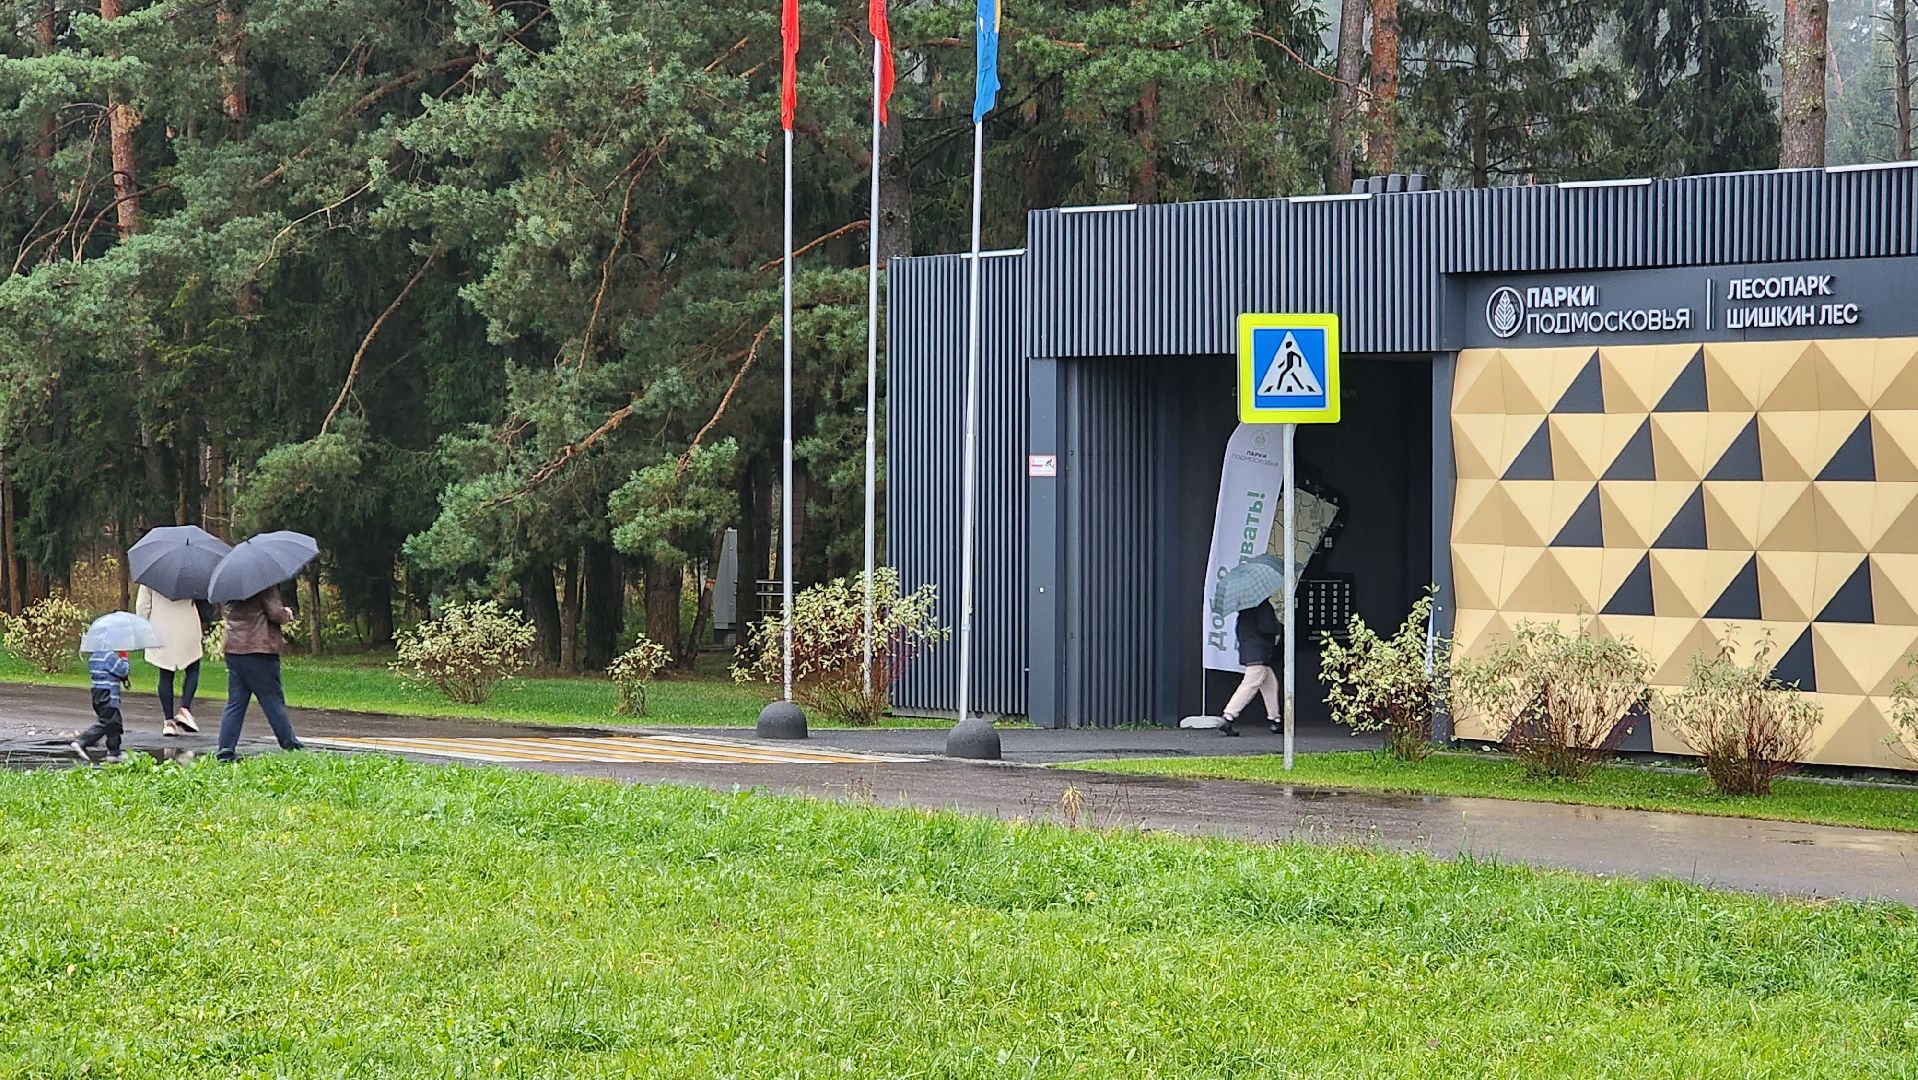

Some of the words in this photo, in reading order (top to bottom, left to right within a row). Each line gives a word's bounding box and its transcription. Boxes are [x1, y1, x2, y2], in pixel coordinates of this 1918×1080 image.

[1526, 286, 1596, 308] ПАРКИ
[1727, 275, 1832, 300] ЛЕСОПАРК
[1526, 308, 1691, 334] ПОДМОСКОВЬЯ
[1727, 304, 1814, 330] ШИШКИН
[1818, 303, 1859, 327] ЛЕС
